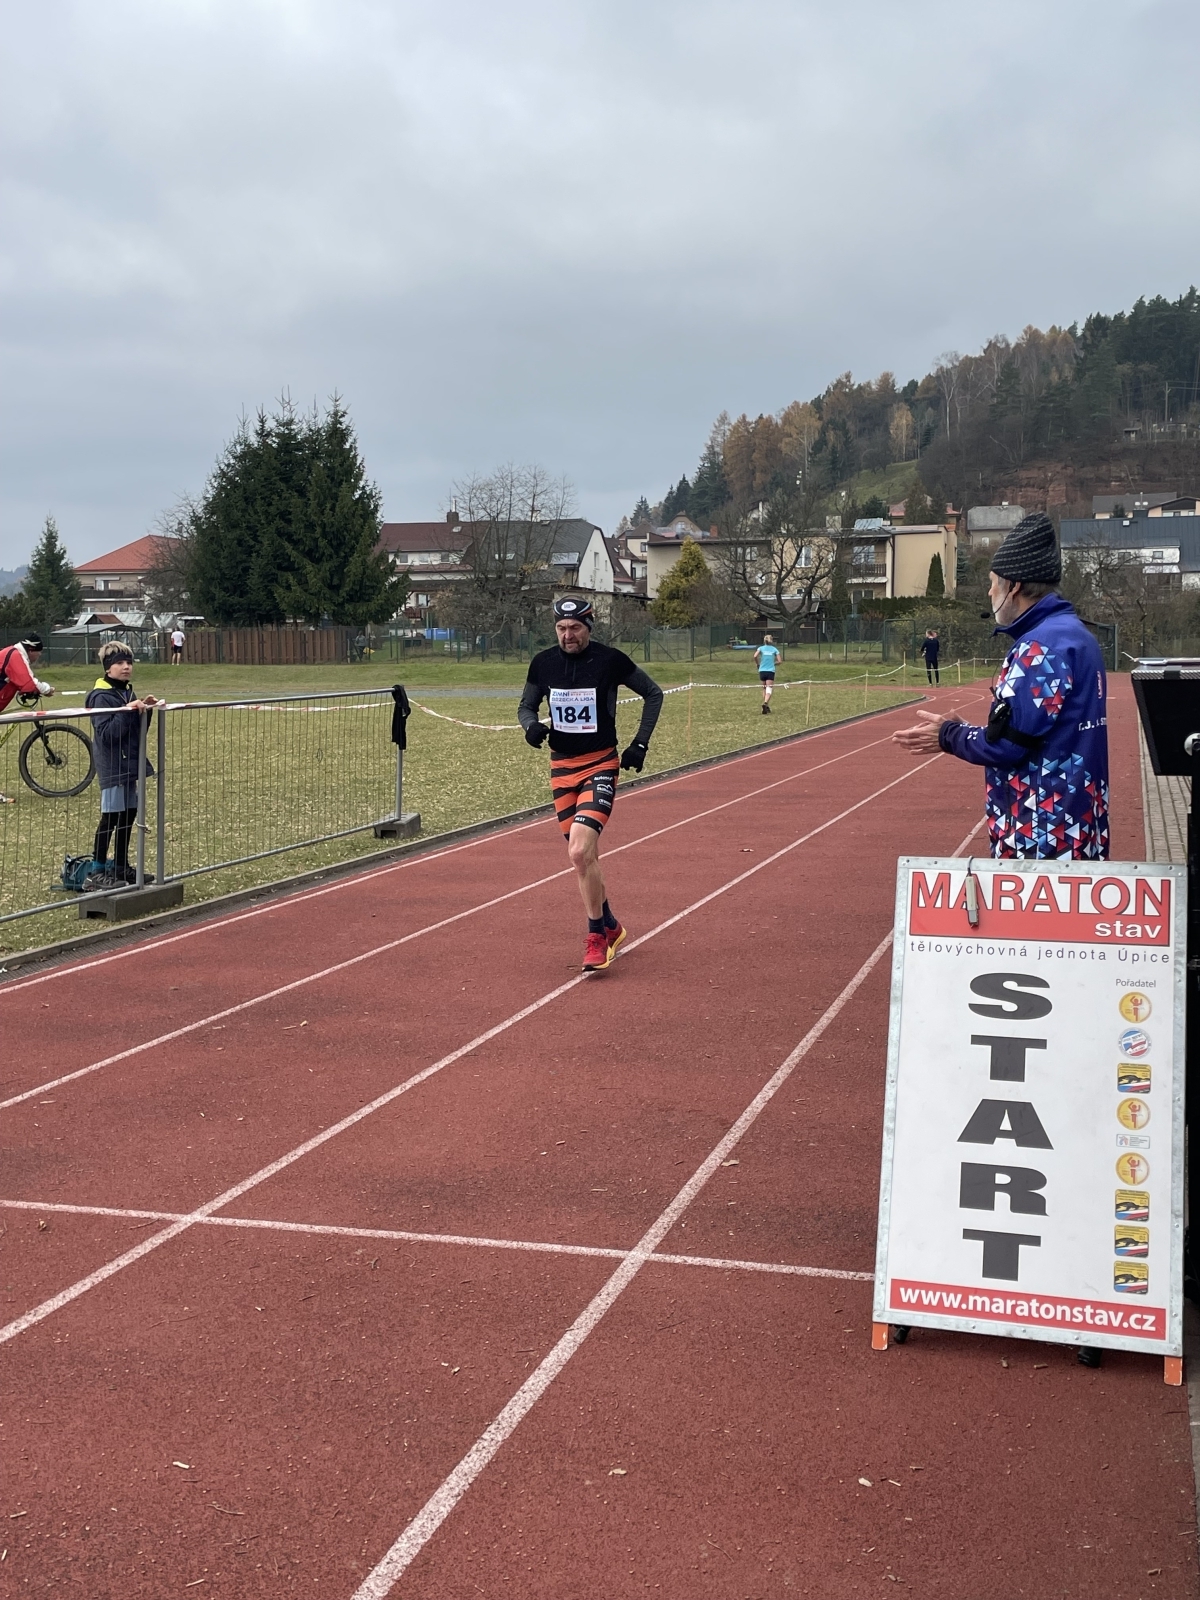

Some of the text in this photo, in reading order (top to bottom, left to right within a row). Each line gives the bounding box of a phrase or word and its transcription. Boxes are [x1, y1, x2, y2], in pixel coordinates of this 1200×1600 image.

[555, 705, 592, 724] 184
[911, 871, 1172, 918] MARATON
[1094, 920, 1163, 939] stav
[910, 940, 1171, 965] tělovýchovná jednota Úpice
[1115, 978, 1157, 989] Pořadatel
[956, 972, 1055, 1282] START
[899, 1286, 1157, 1332] www.maratonstav.cz
